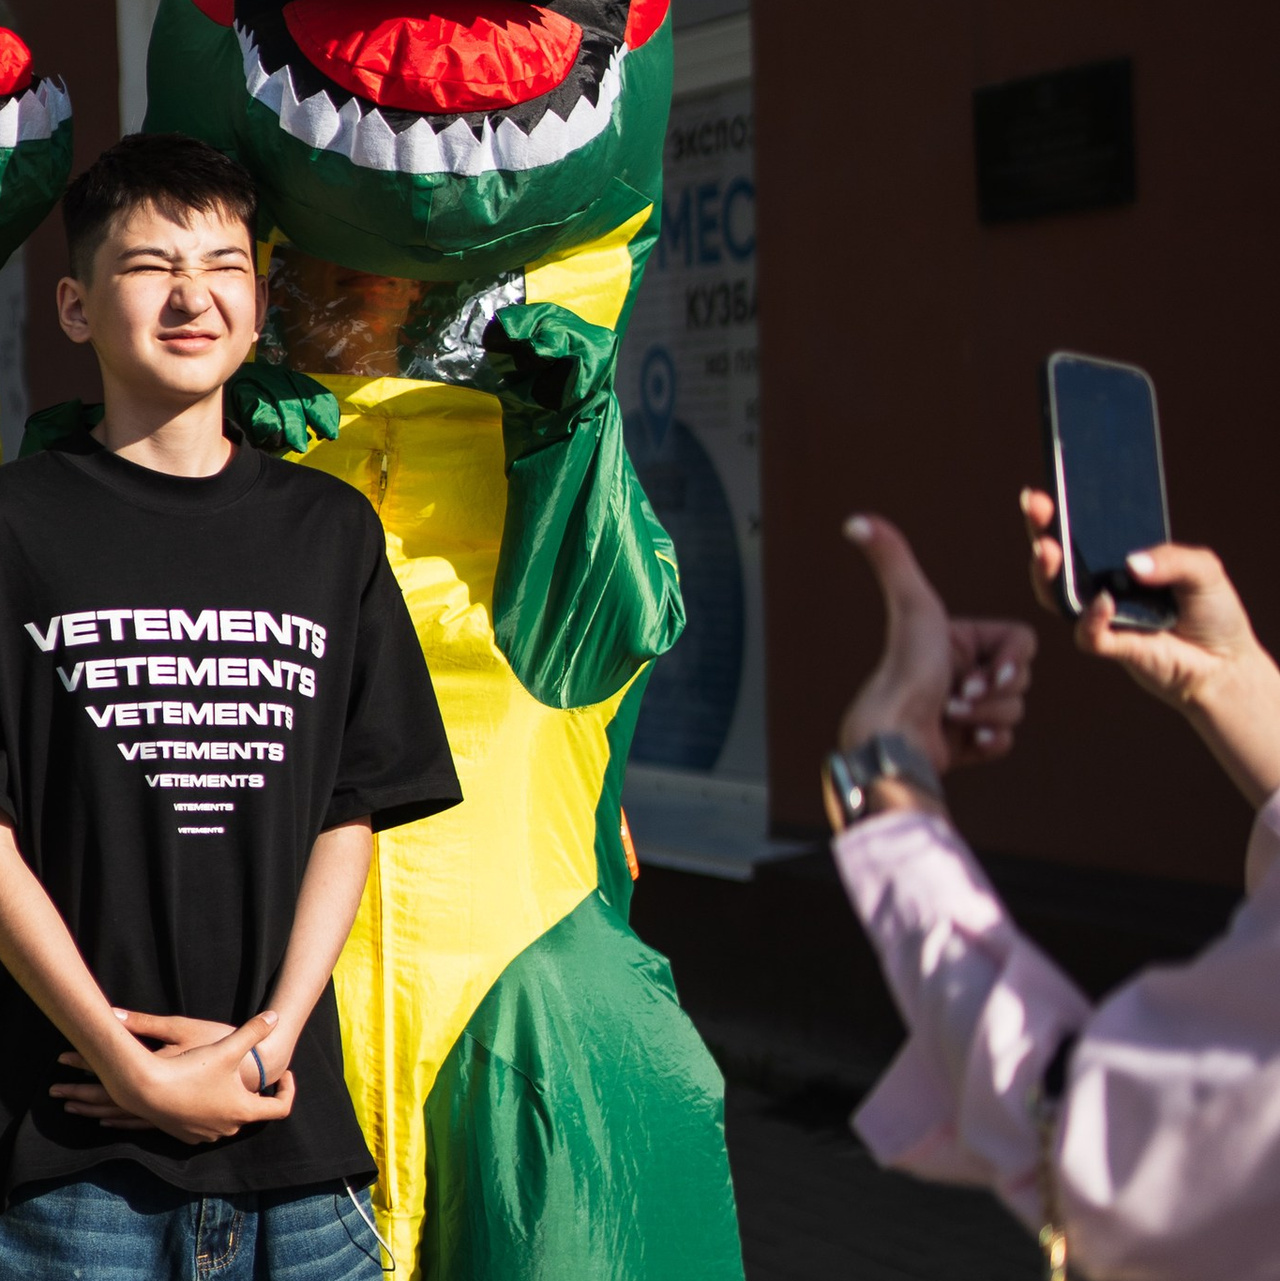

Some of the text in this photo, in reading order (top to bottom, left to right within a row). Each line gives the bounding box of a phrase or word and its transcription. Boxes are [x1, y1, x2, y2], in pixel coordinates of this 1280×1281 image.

[24, 609, 327, 659] VETEMENTS
[56, 657, 316, 698] VETEMENTS
[85, 701, 293, 730] VETEMENTS
[117, 741, 284, 761] VETEMENTS
[145, 773, 264, 788] VETEMENTS
[173, 803, 234, 812] VETEMENTS
